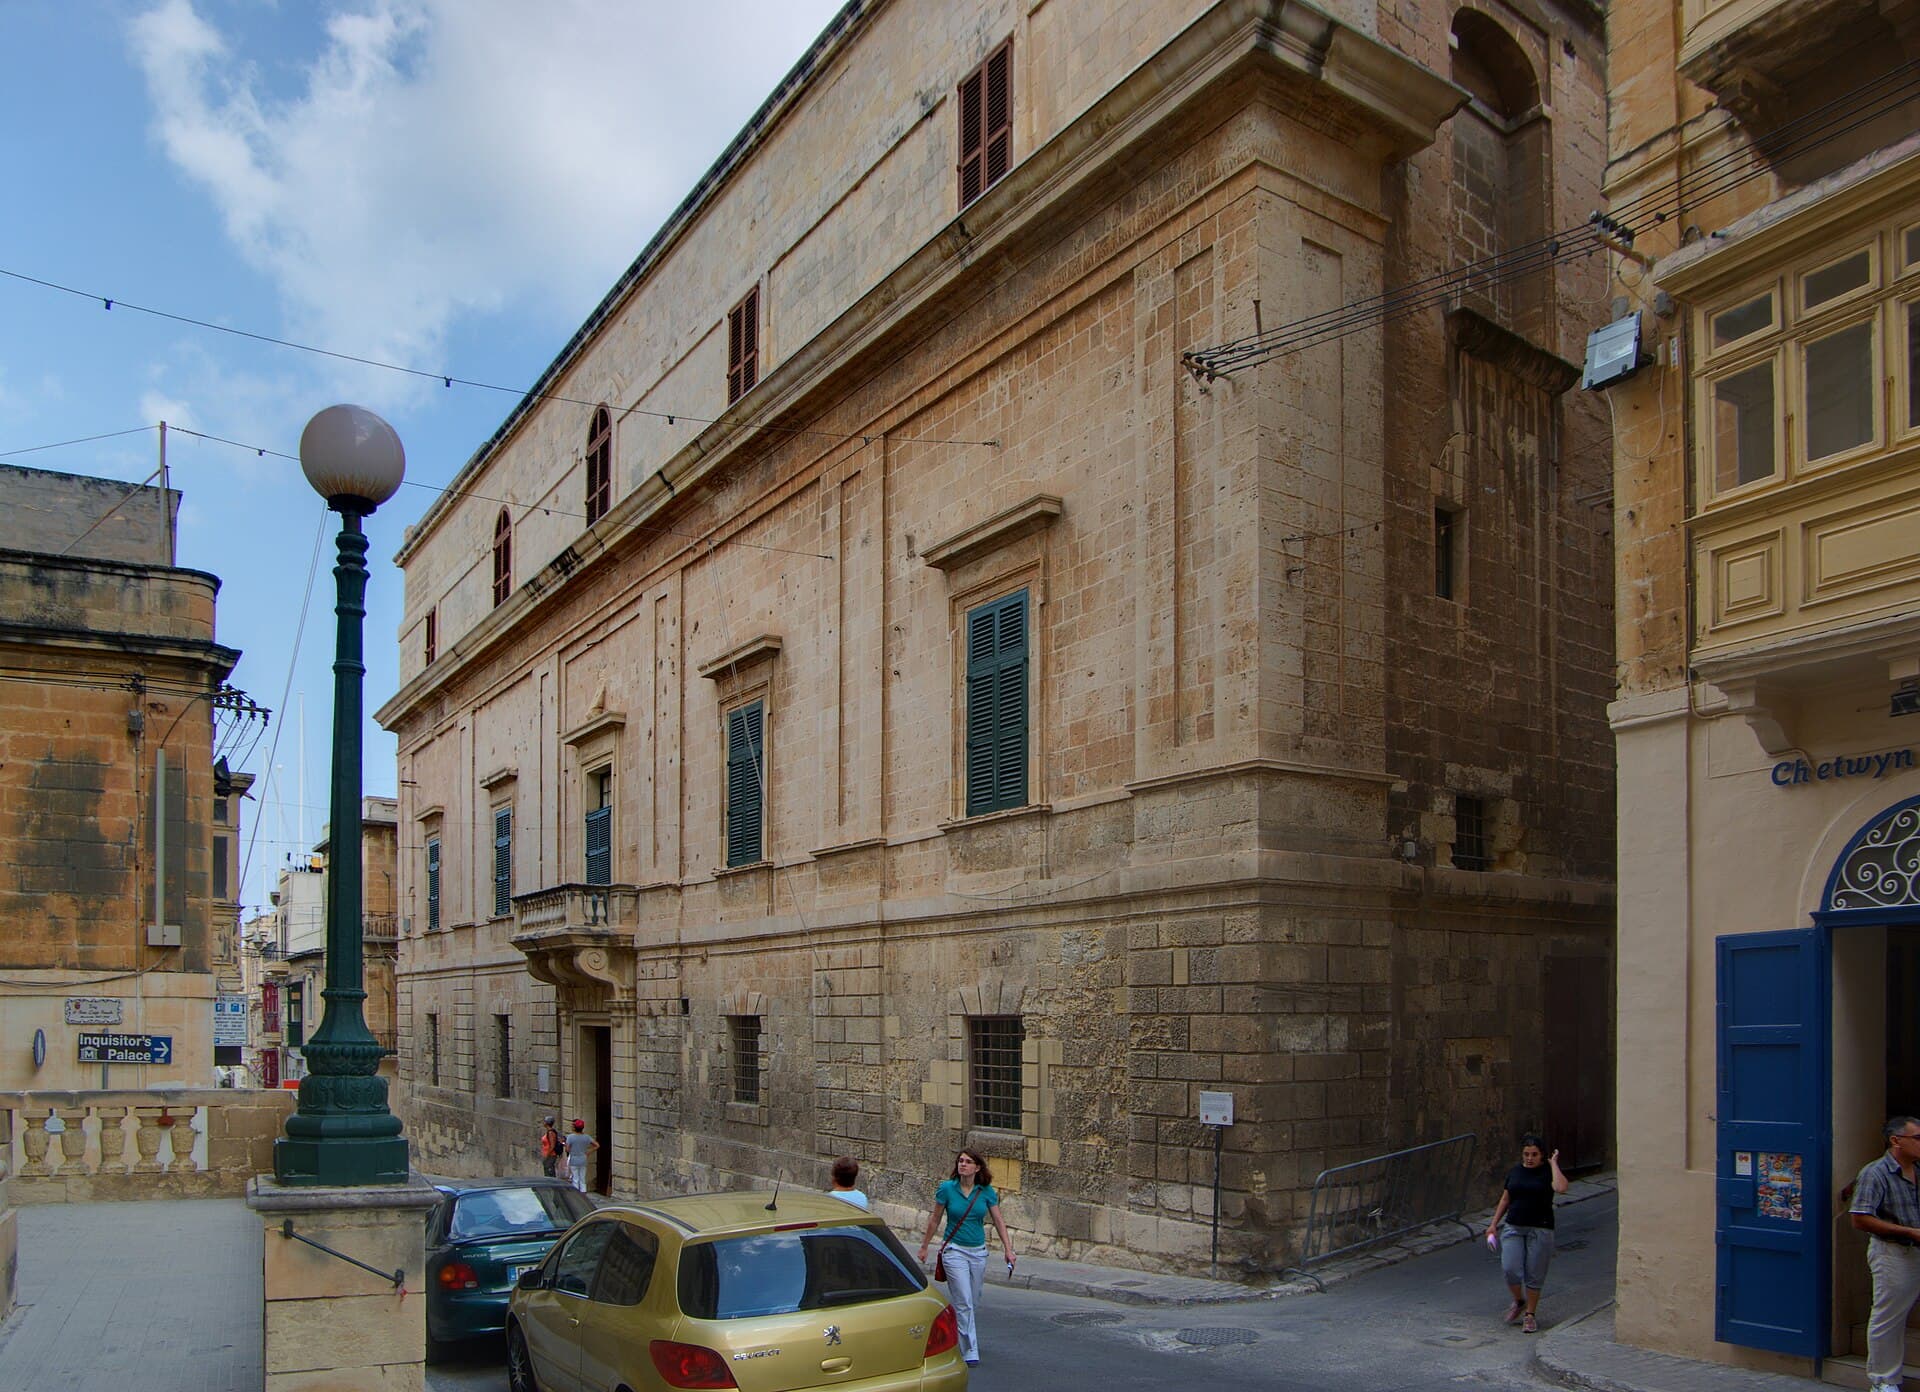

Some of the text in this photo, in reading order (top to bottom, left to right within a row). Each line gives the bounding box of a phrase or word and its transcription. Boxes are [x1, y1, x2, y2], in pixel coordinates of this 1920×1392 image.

[1771, 748, 1913, 786] Chetwyn
[79, 1034, 152, 1048] Inquisitor's
[108, 1049, 152, 1061] Palace
[733, 1348, 781, 1360] PEUGEOT
